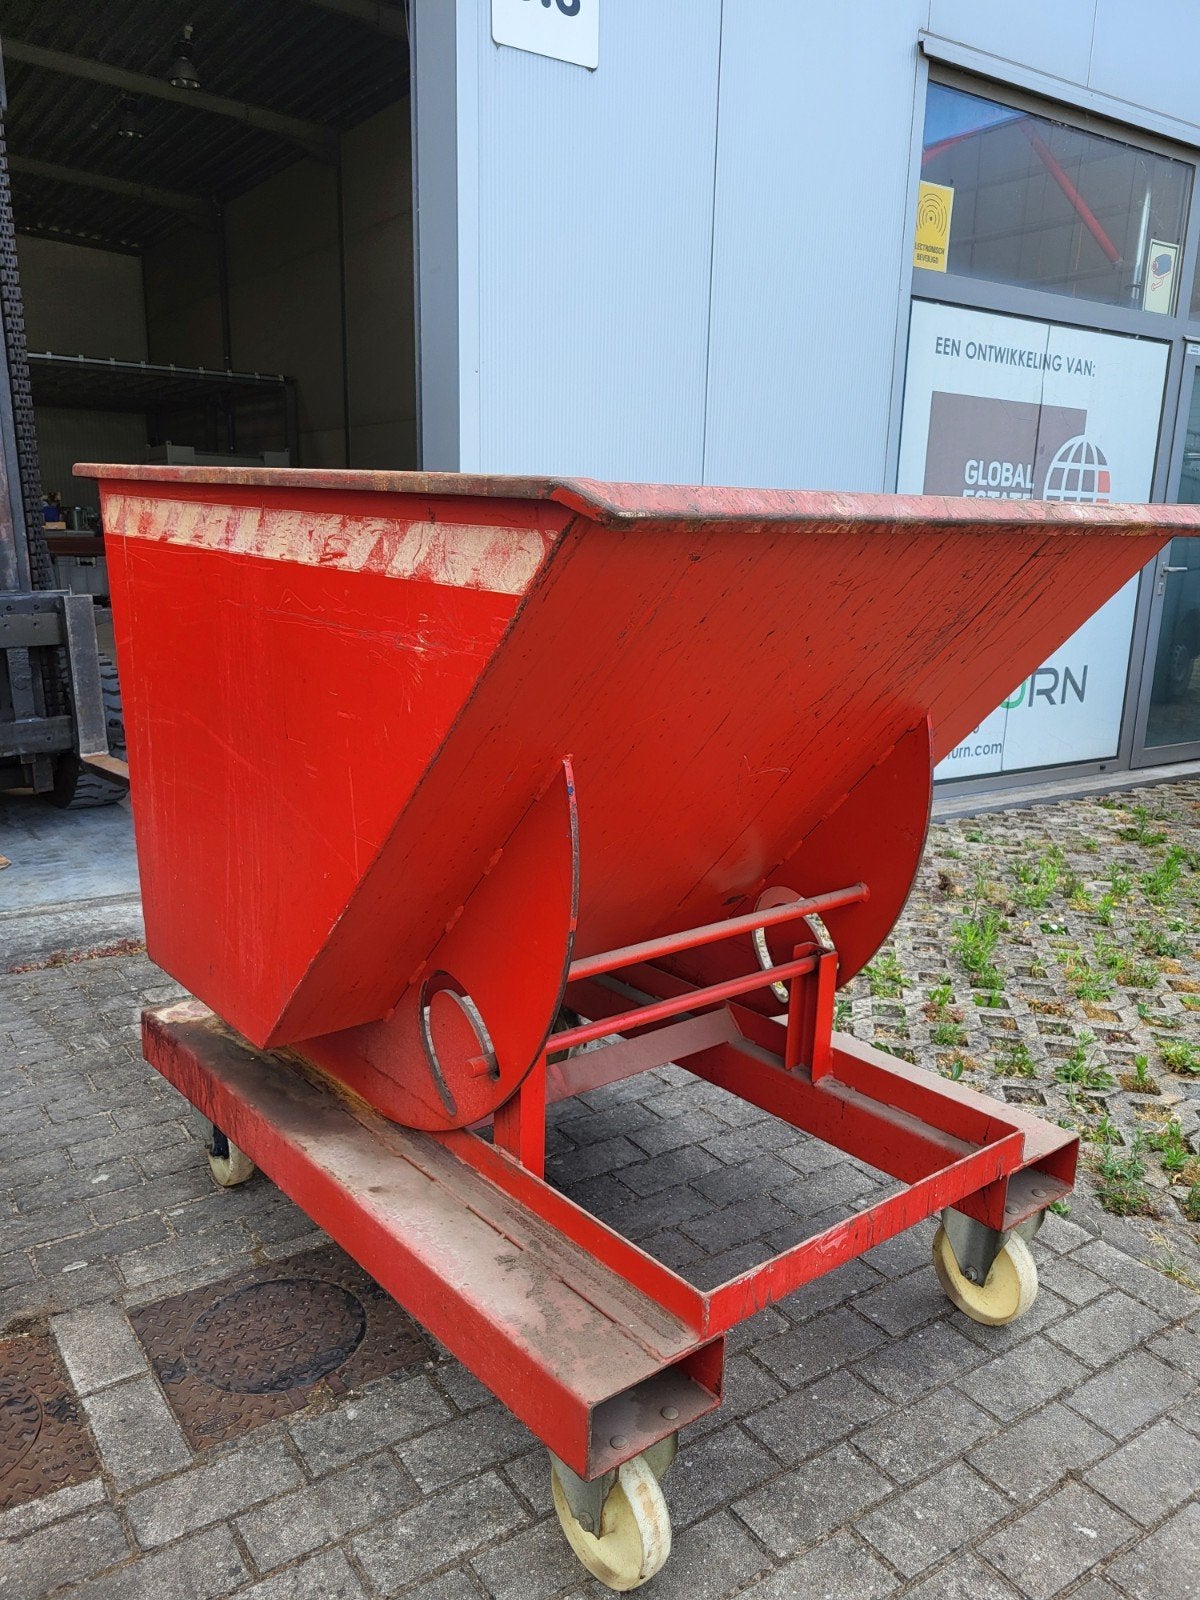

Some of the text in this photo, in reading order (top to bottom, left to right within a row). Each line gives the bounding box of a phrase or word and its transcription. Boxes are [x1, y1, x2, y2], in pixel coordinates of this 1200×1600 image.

[935, 336, 1096, 378] EEN ONTWIKKELING VAN:
[964, 459, 1035, 489] GLOBAL
